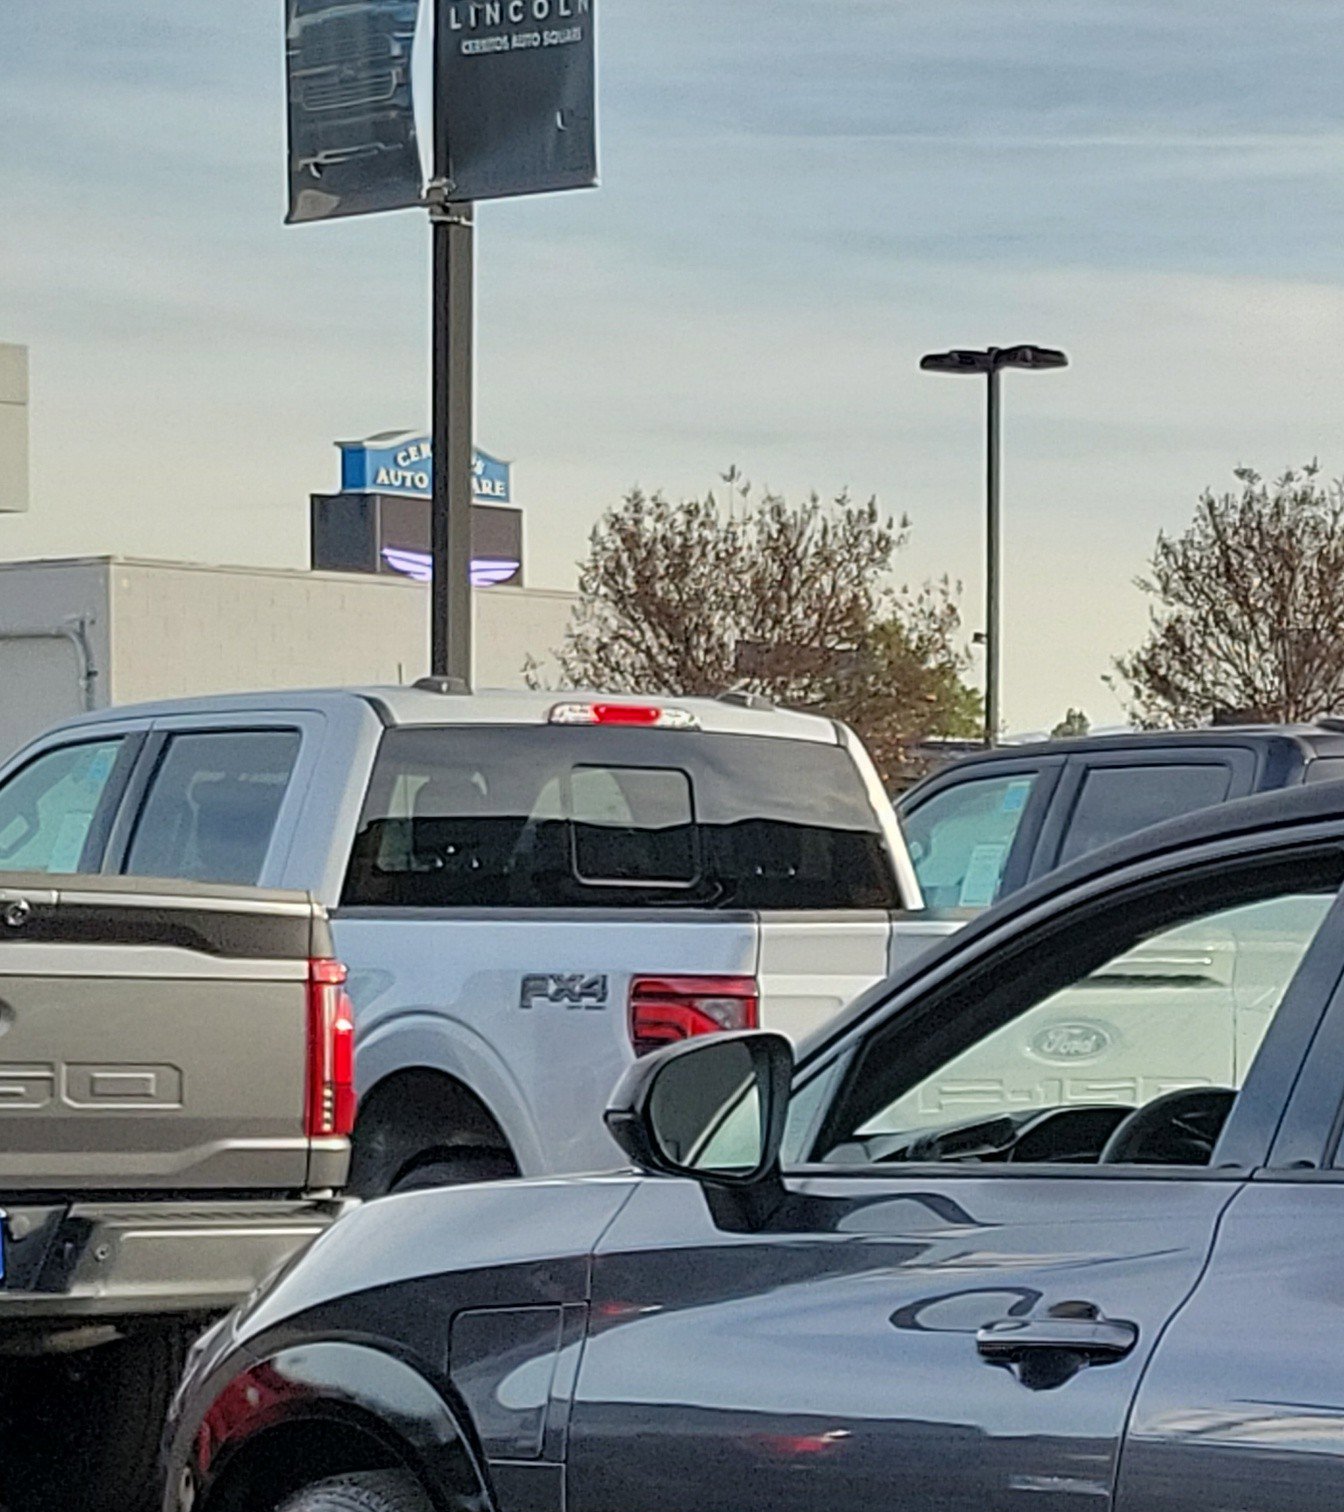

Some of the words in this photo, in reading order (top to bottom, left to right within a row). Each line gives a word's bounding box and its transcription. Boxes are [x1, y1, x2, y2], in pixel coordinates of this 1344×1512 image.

[450, 0, 588, 30] LINCOLN
[376, 467, 429, 488] AUTO
[520, 974, 609, 1008] FX4
